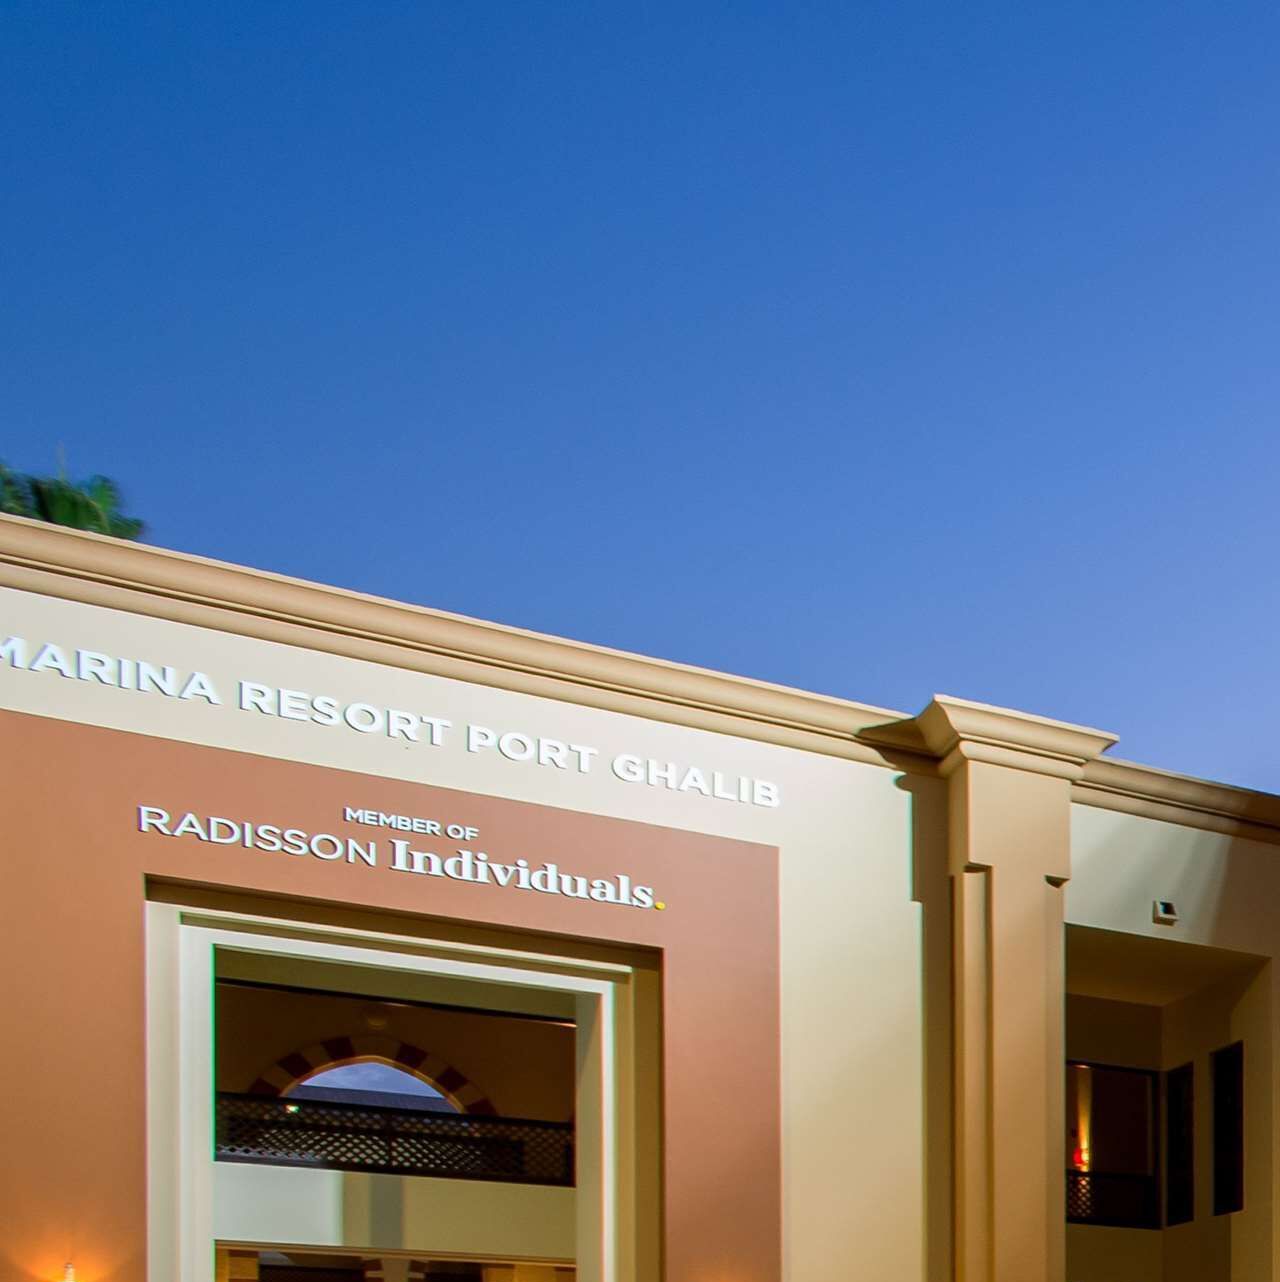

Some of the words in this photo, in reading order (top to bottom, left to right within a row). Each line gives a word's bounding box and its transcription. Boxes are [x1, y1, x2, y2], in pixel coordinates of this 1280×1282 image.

[239, 680, 451, 746] RESORT
[466, 724, 599, 774] PORT
[611, 755, 780, 808] GHALIB
[137, 805, 377, 867] RADISSON
[344, 807, 441, 836] MEMBER
[446, 823, 480, 841] OF
